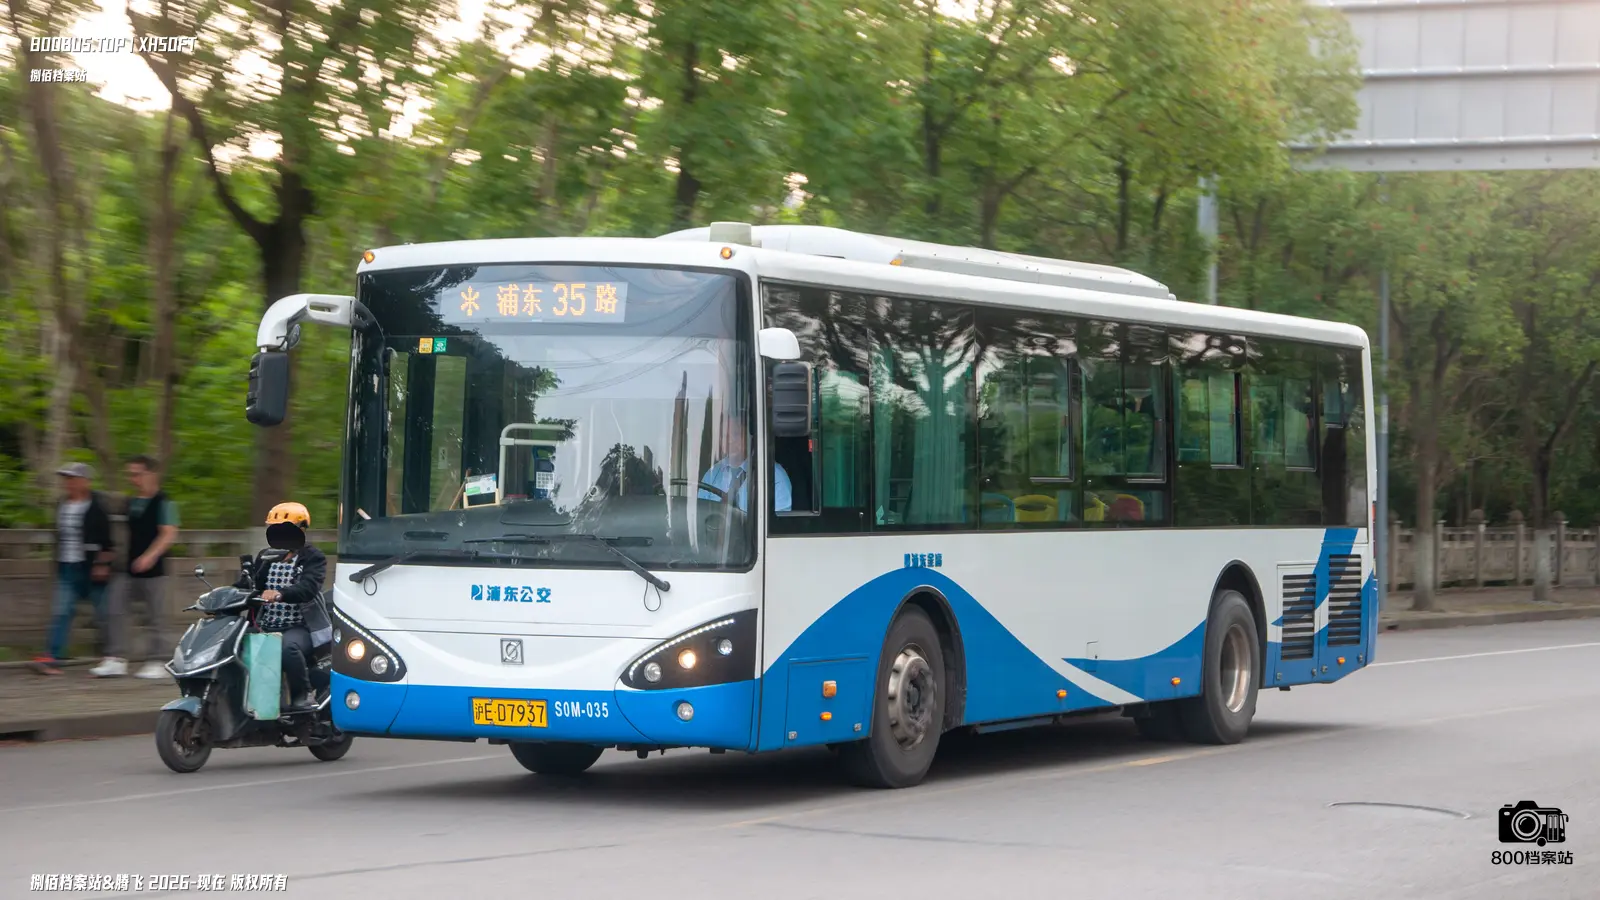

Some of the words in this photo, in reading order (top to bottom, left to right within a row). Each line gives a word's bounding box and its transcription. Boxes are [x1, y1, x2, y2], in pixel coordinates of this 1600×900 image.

[497, 283, 543, 316] 浦东
[552, 283, 587, 316] 35
[594, 283, 618, 314] 路
[486, 584, 552, 604] 浦东公交
